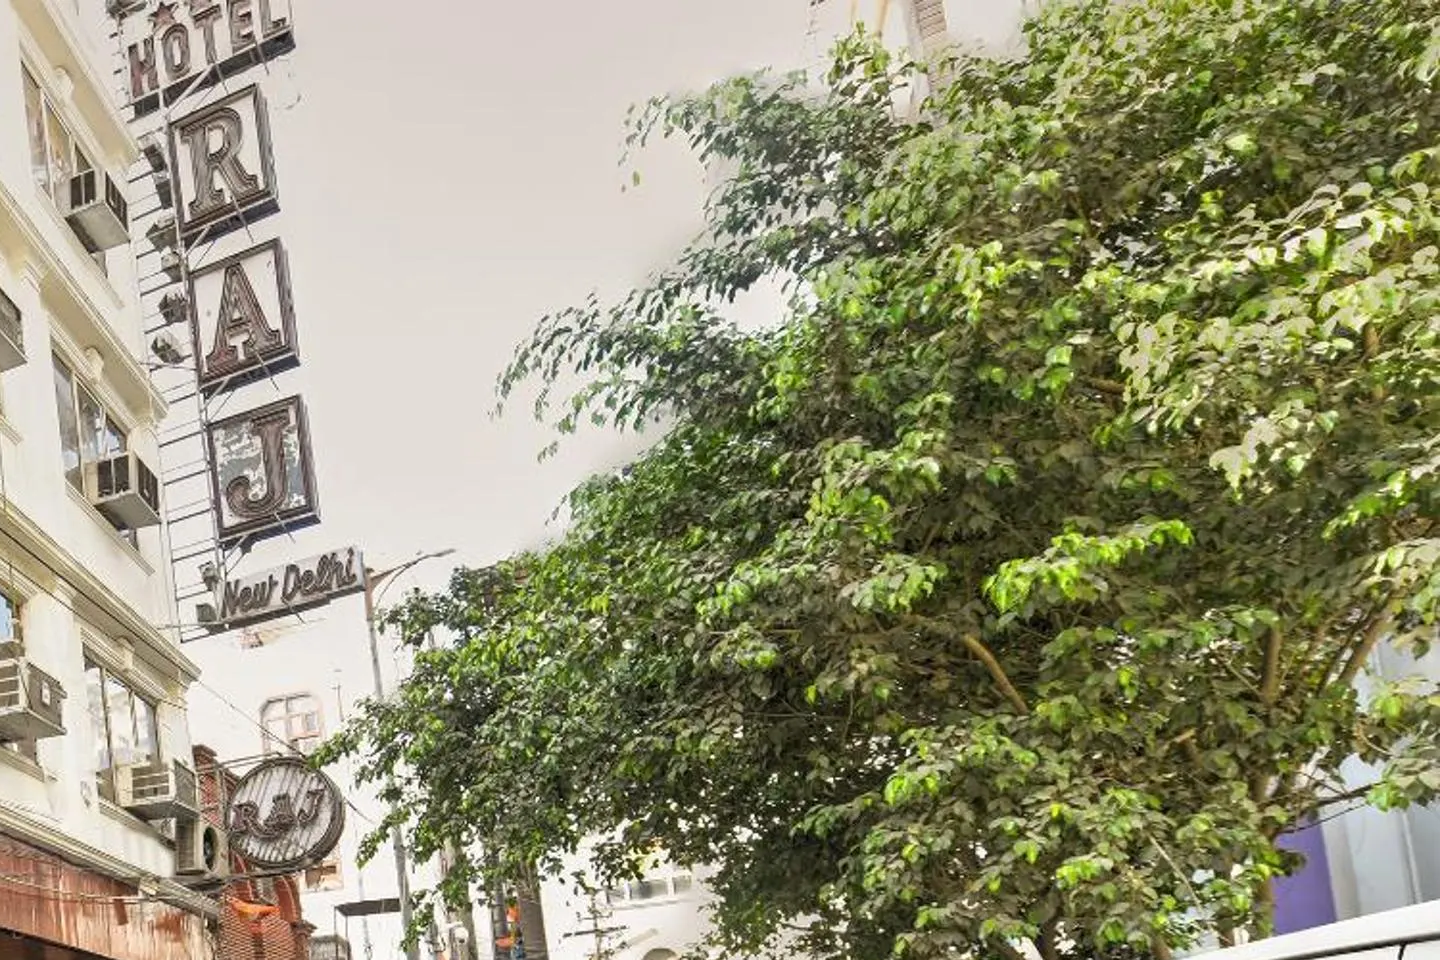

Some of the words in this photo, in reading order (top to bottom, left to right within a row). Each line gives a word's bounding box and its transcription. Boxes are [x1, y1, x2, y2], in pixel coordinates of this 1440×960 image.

[127, 0, 288, 99] HOTEL
[221, 573, 279, 619] New
[281, 547, 358, 602] Delhi
[230, 788, 325, 839] RAJ
